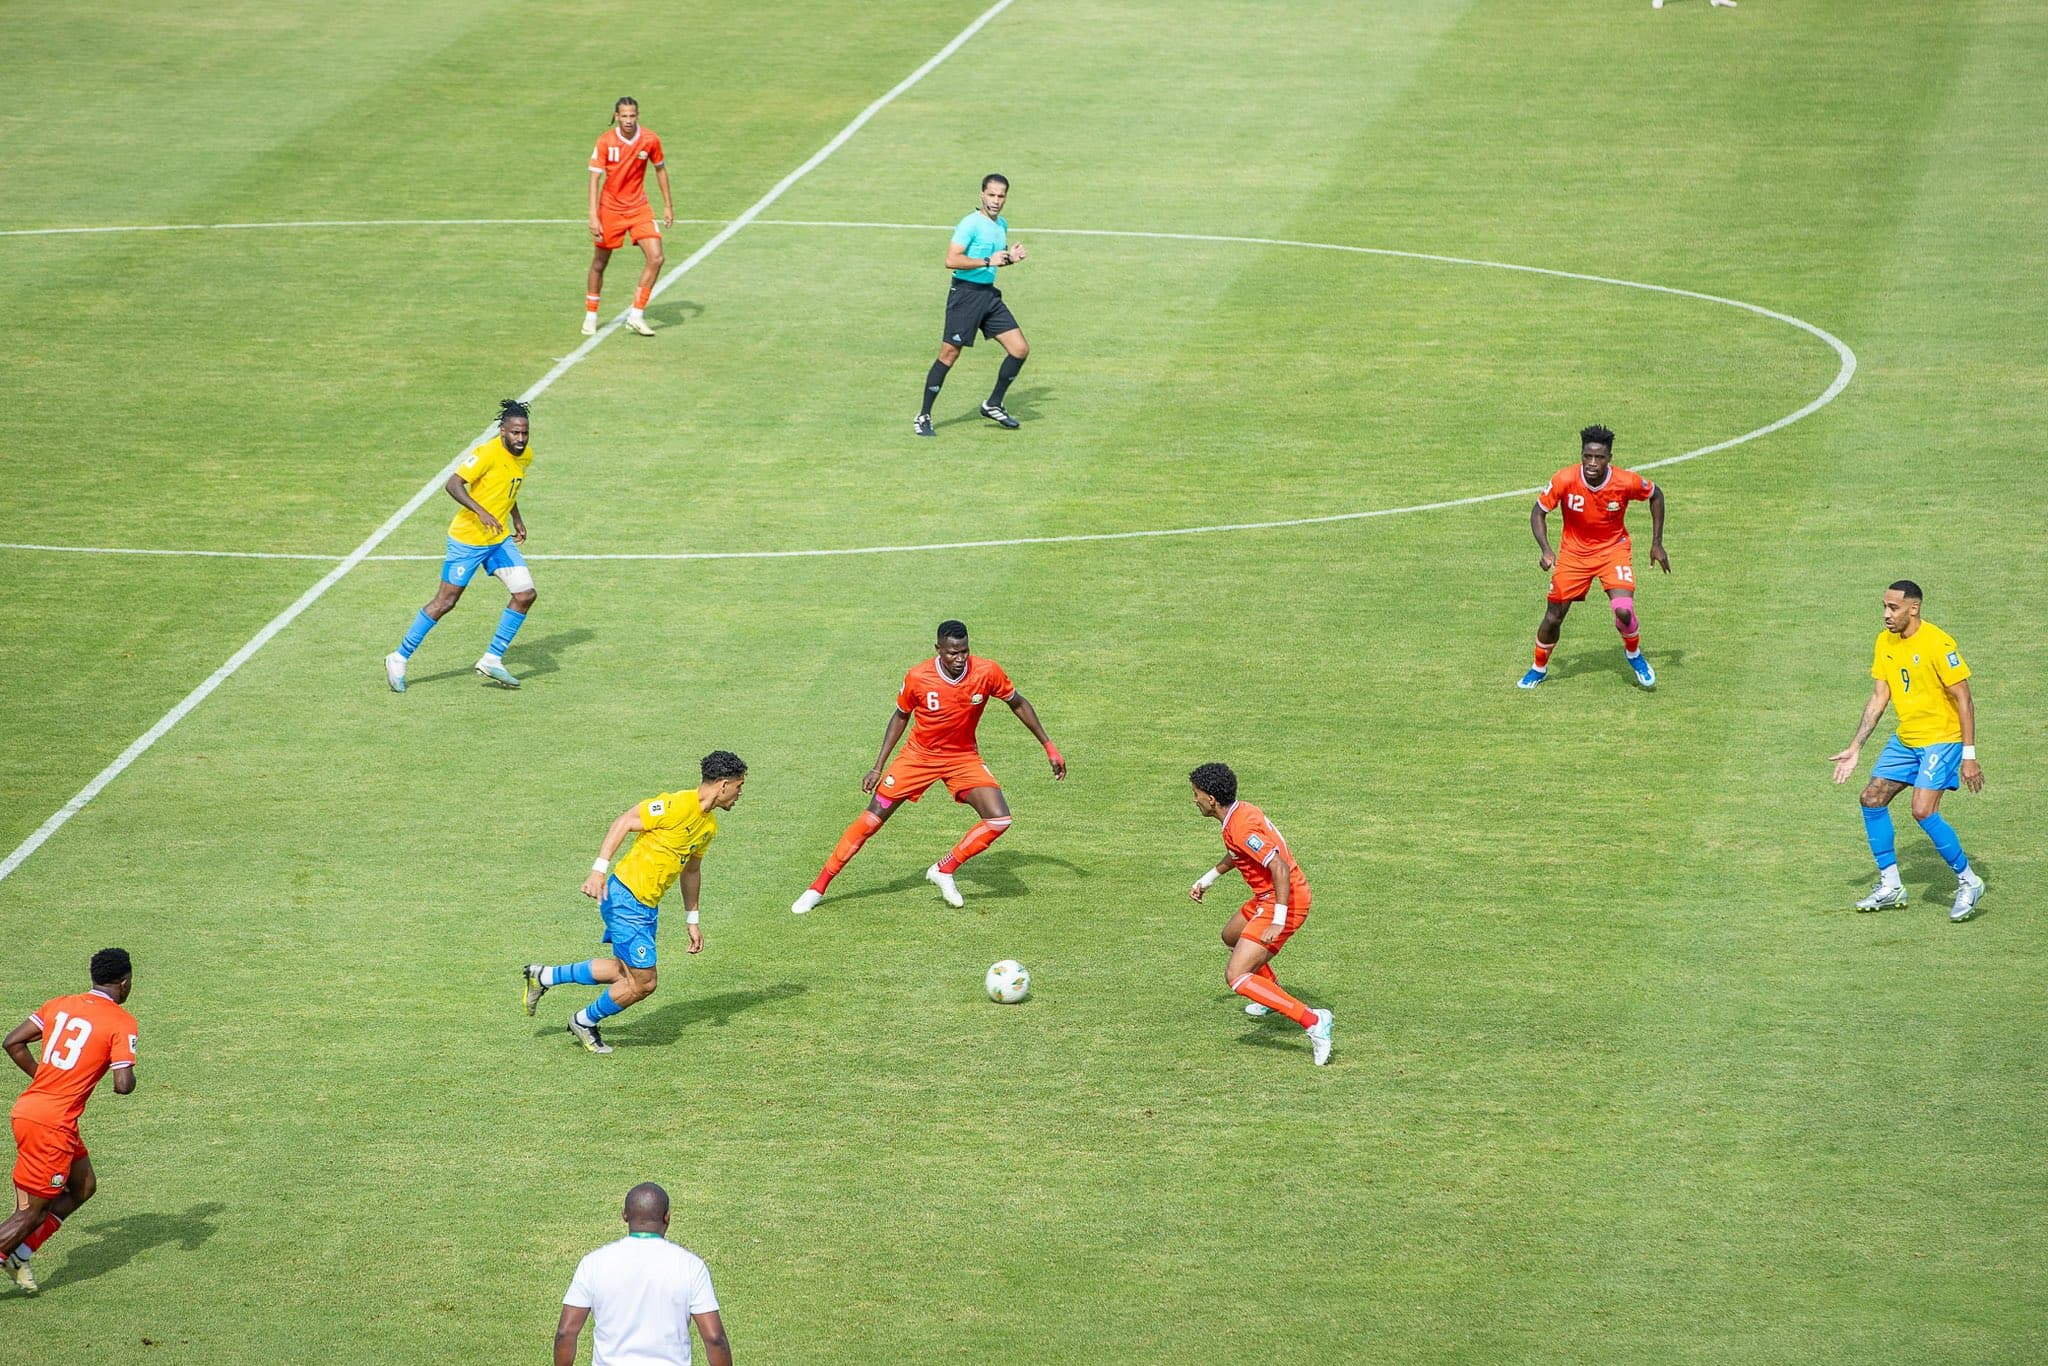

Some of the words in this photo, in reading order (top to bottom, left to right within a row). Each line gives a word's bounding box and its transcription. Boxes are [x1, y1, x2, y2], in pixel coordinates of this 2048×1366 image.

[607, 146, 620, 162] 11
[1567, 493, 1584, 512] 12
[1615, 565, 1633, 583] 12
[1900, 668, 1910, 692] 9
[927, 691, 939, 710] 6
[1929, 753, 1939, 770] 9
[42, 1010, 93, 1071] 13
